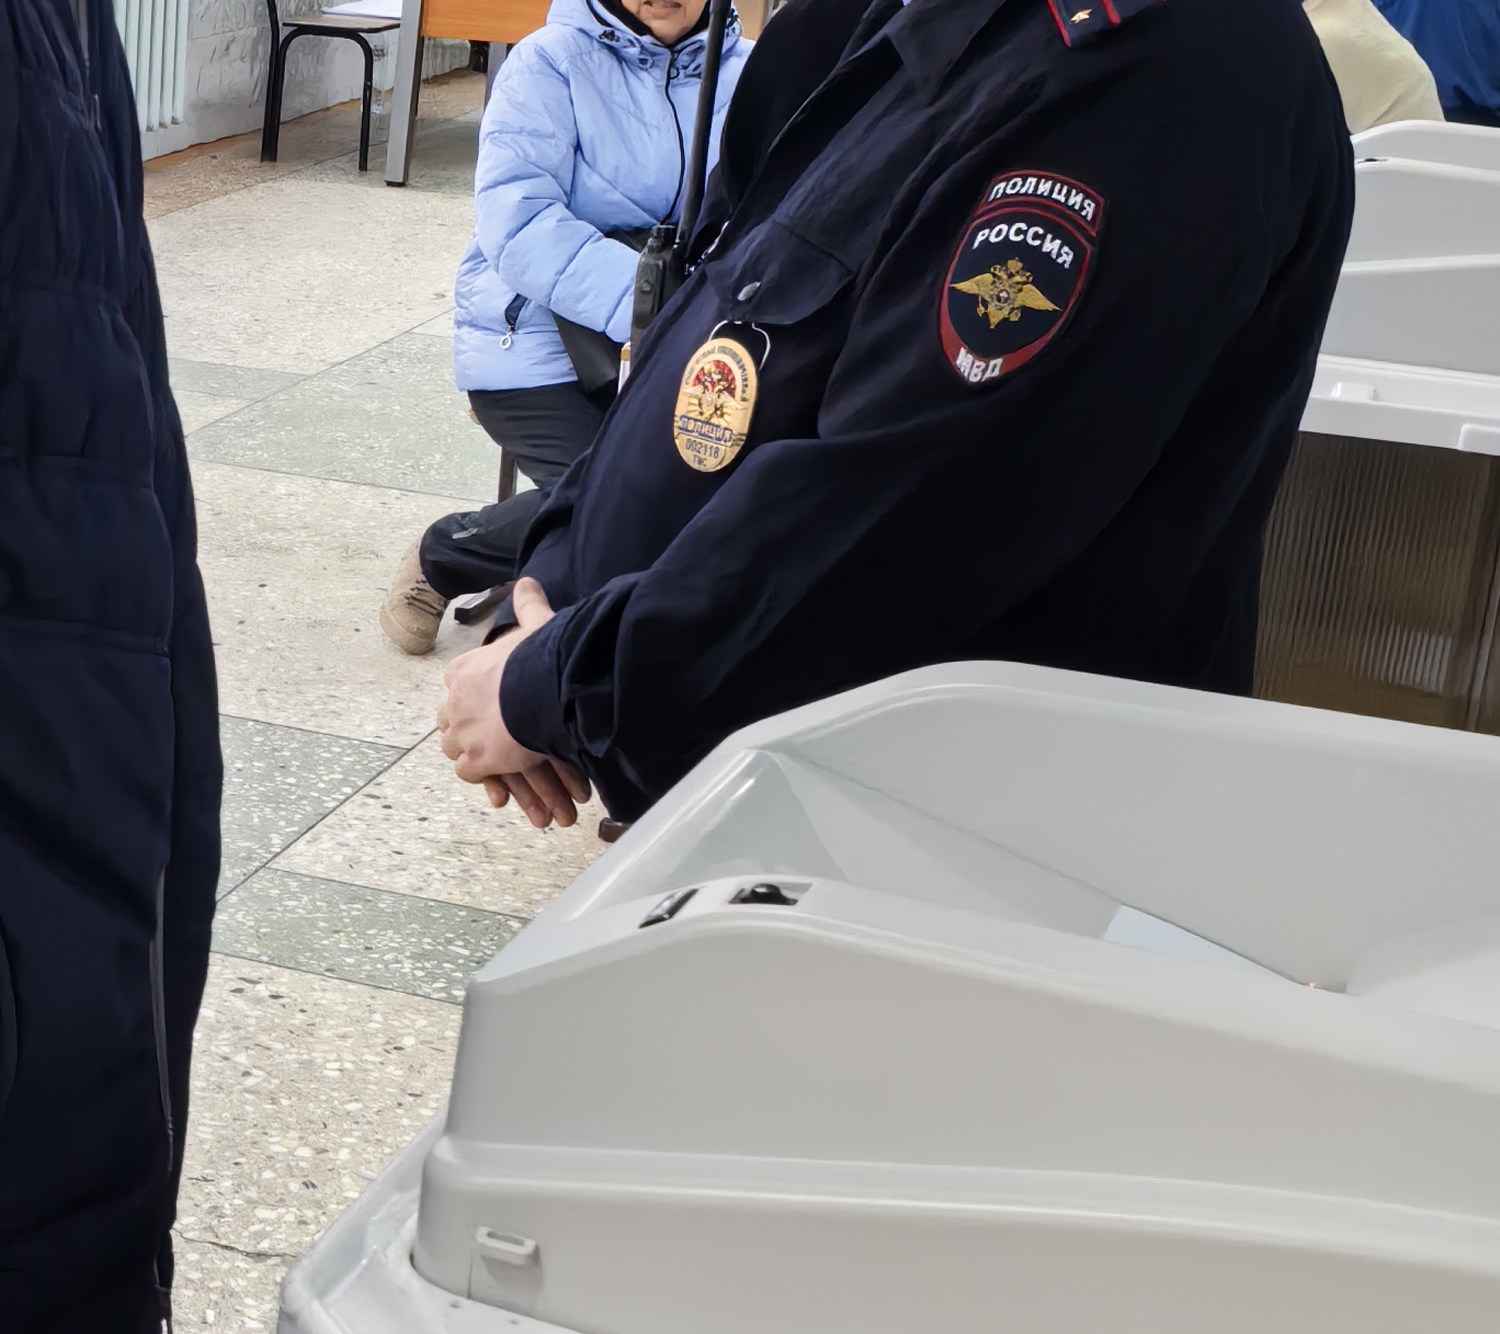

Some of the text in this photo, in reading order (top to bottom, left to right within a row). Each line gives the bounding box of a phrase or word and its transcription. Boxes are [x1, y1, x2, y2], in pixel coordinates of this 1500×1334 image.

[988, 177, 1097, 222] ПОЛИЦИЯ
[972, 222, 1075, 269] РОССИЯ
[955, 347, 1003, 383] МВД
[680, 417, 732, 444] ПОЛИЦИЯ
